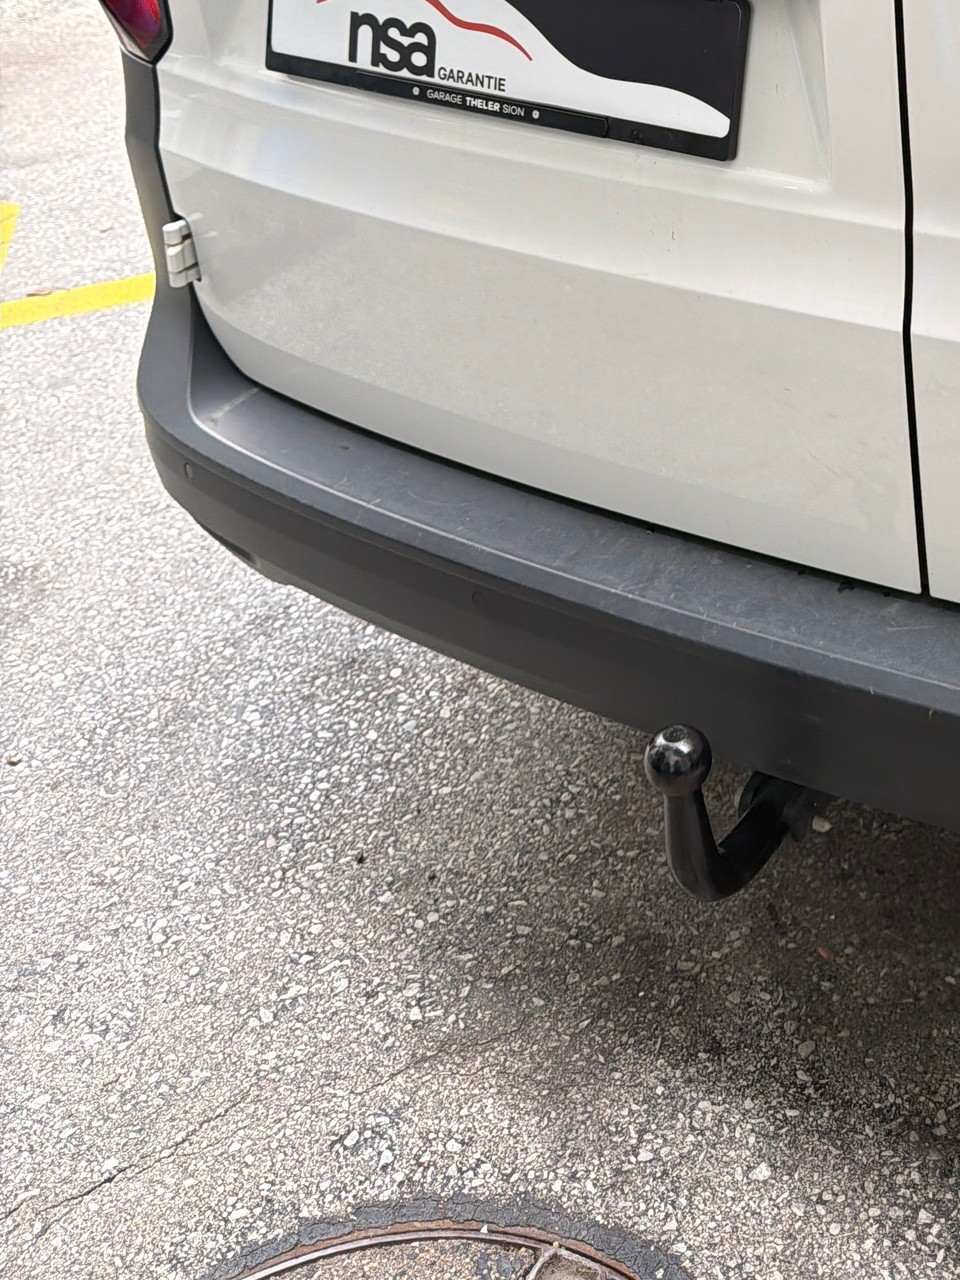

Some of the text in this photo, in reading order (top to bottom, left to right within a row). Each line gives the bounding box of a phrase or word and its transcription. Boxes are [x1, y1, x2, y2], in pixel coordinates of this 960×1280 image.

[348, 10, 437, 78] nsa
[437, 66, 507, 92] GARANTIE
[426, 89, 525, 117] GARAGE THELER SION
